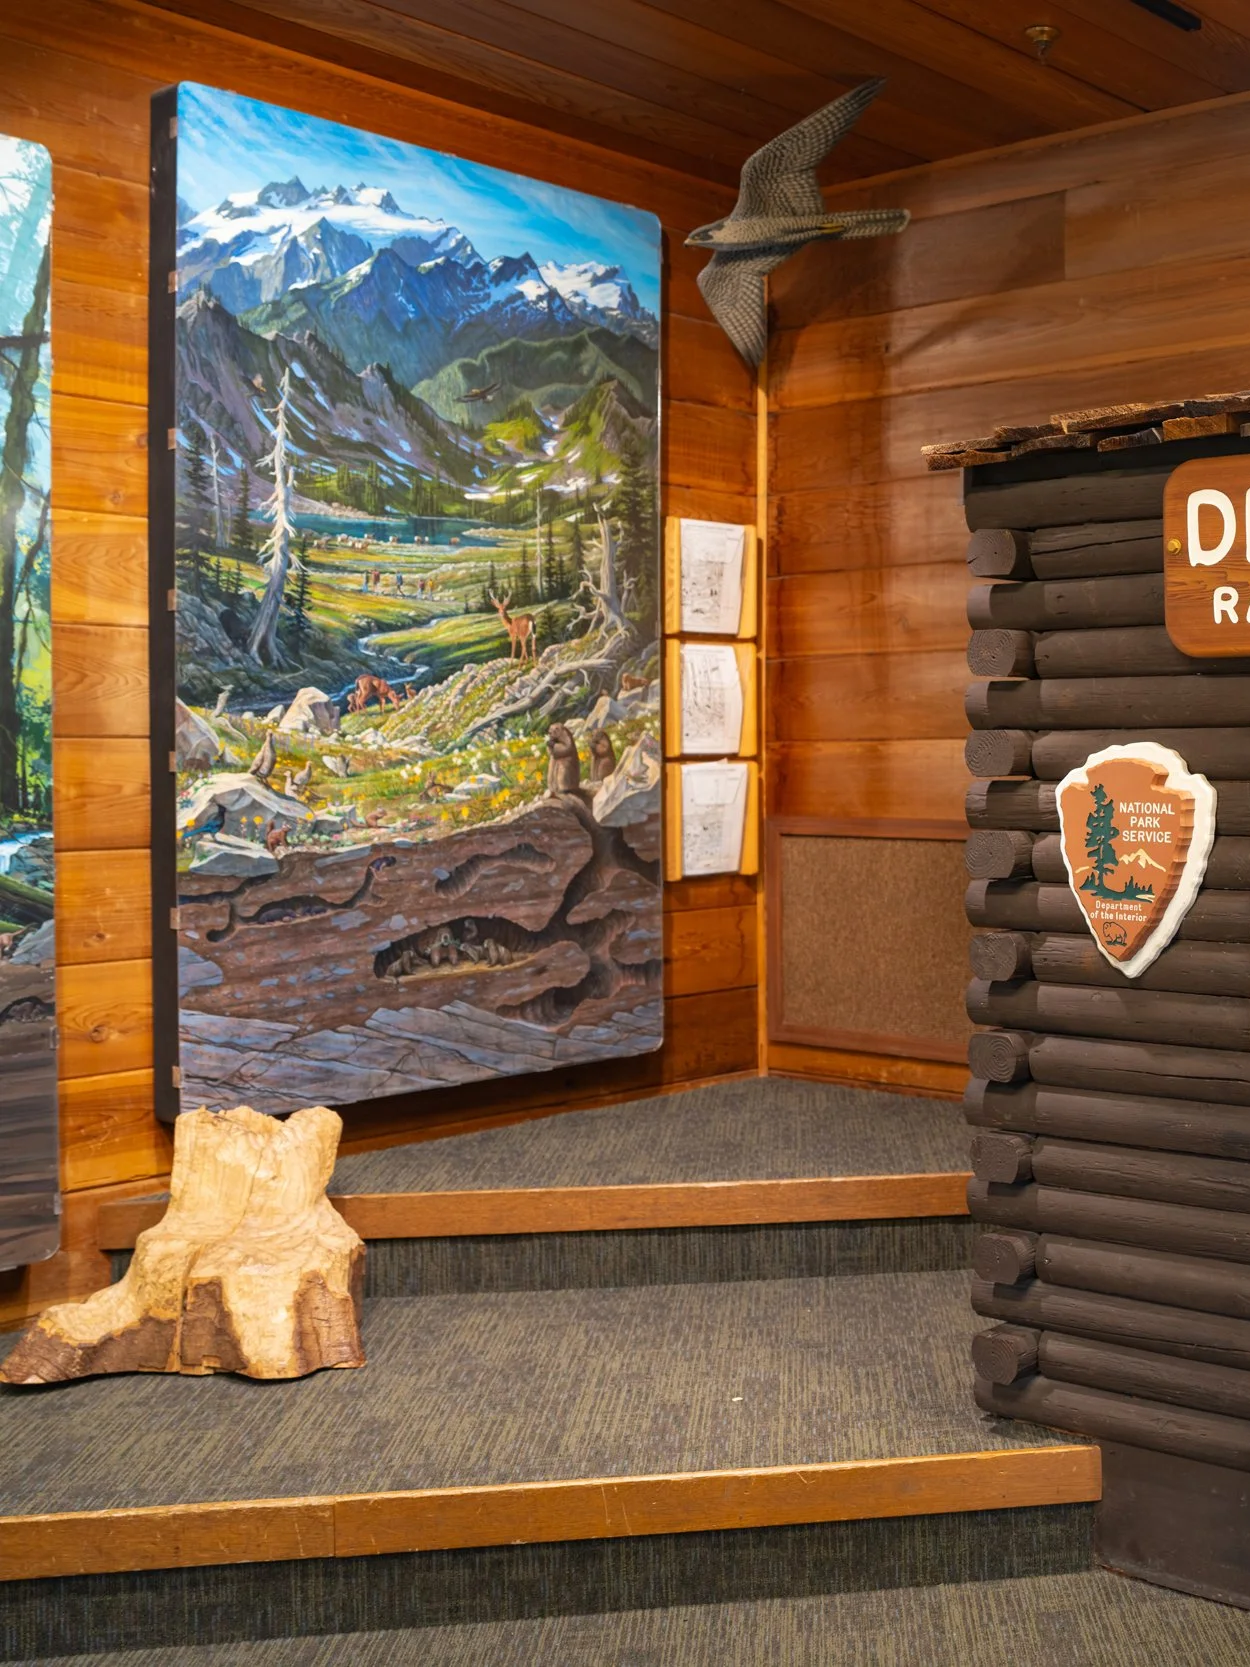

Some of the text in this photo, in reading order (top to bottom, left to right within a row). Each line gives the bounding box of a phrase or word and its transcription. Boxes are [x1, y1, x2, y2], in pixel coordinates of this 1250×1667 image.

[1119, 801, 1176, 816] NATIONAL
[1130, 815, 1161, 829] PARK
[1122, 829, 1172, 844] SERVICE
[1095, 900, 1142, 912] Department
[1090, 910, 1148, 922] of the Interior
